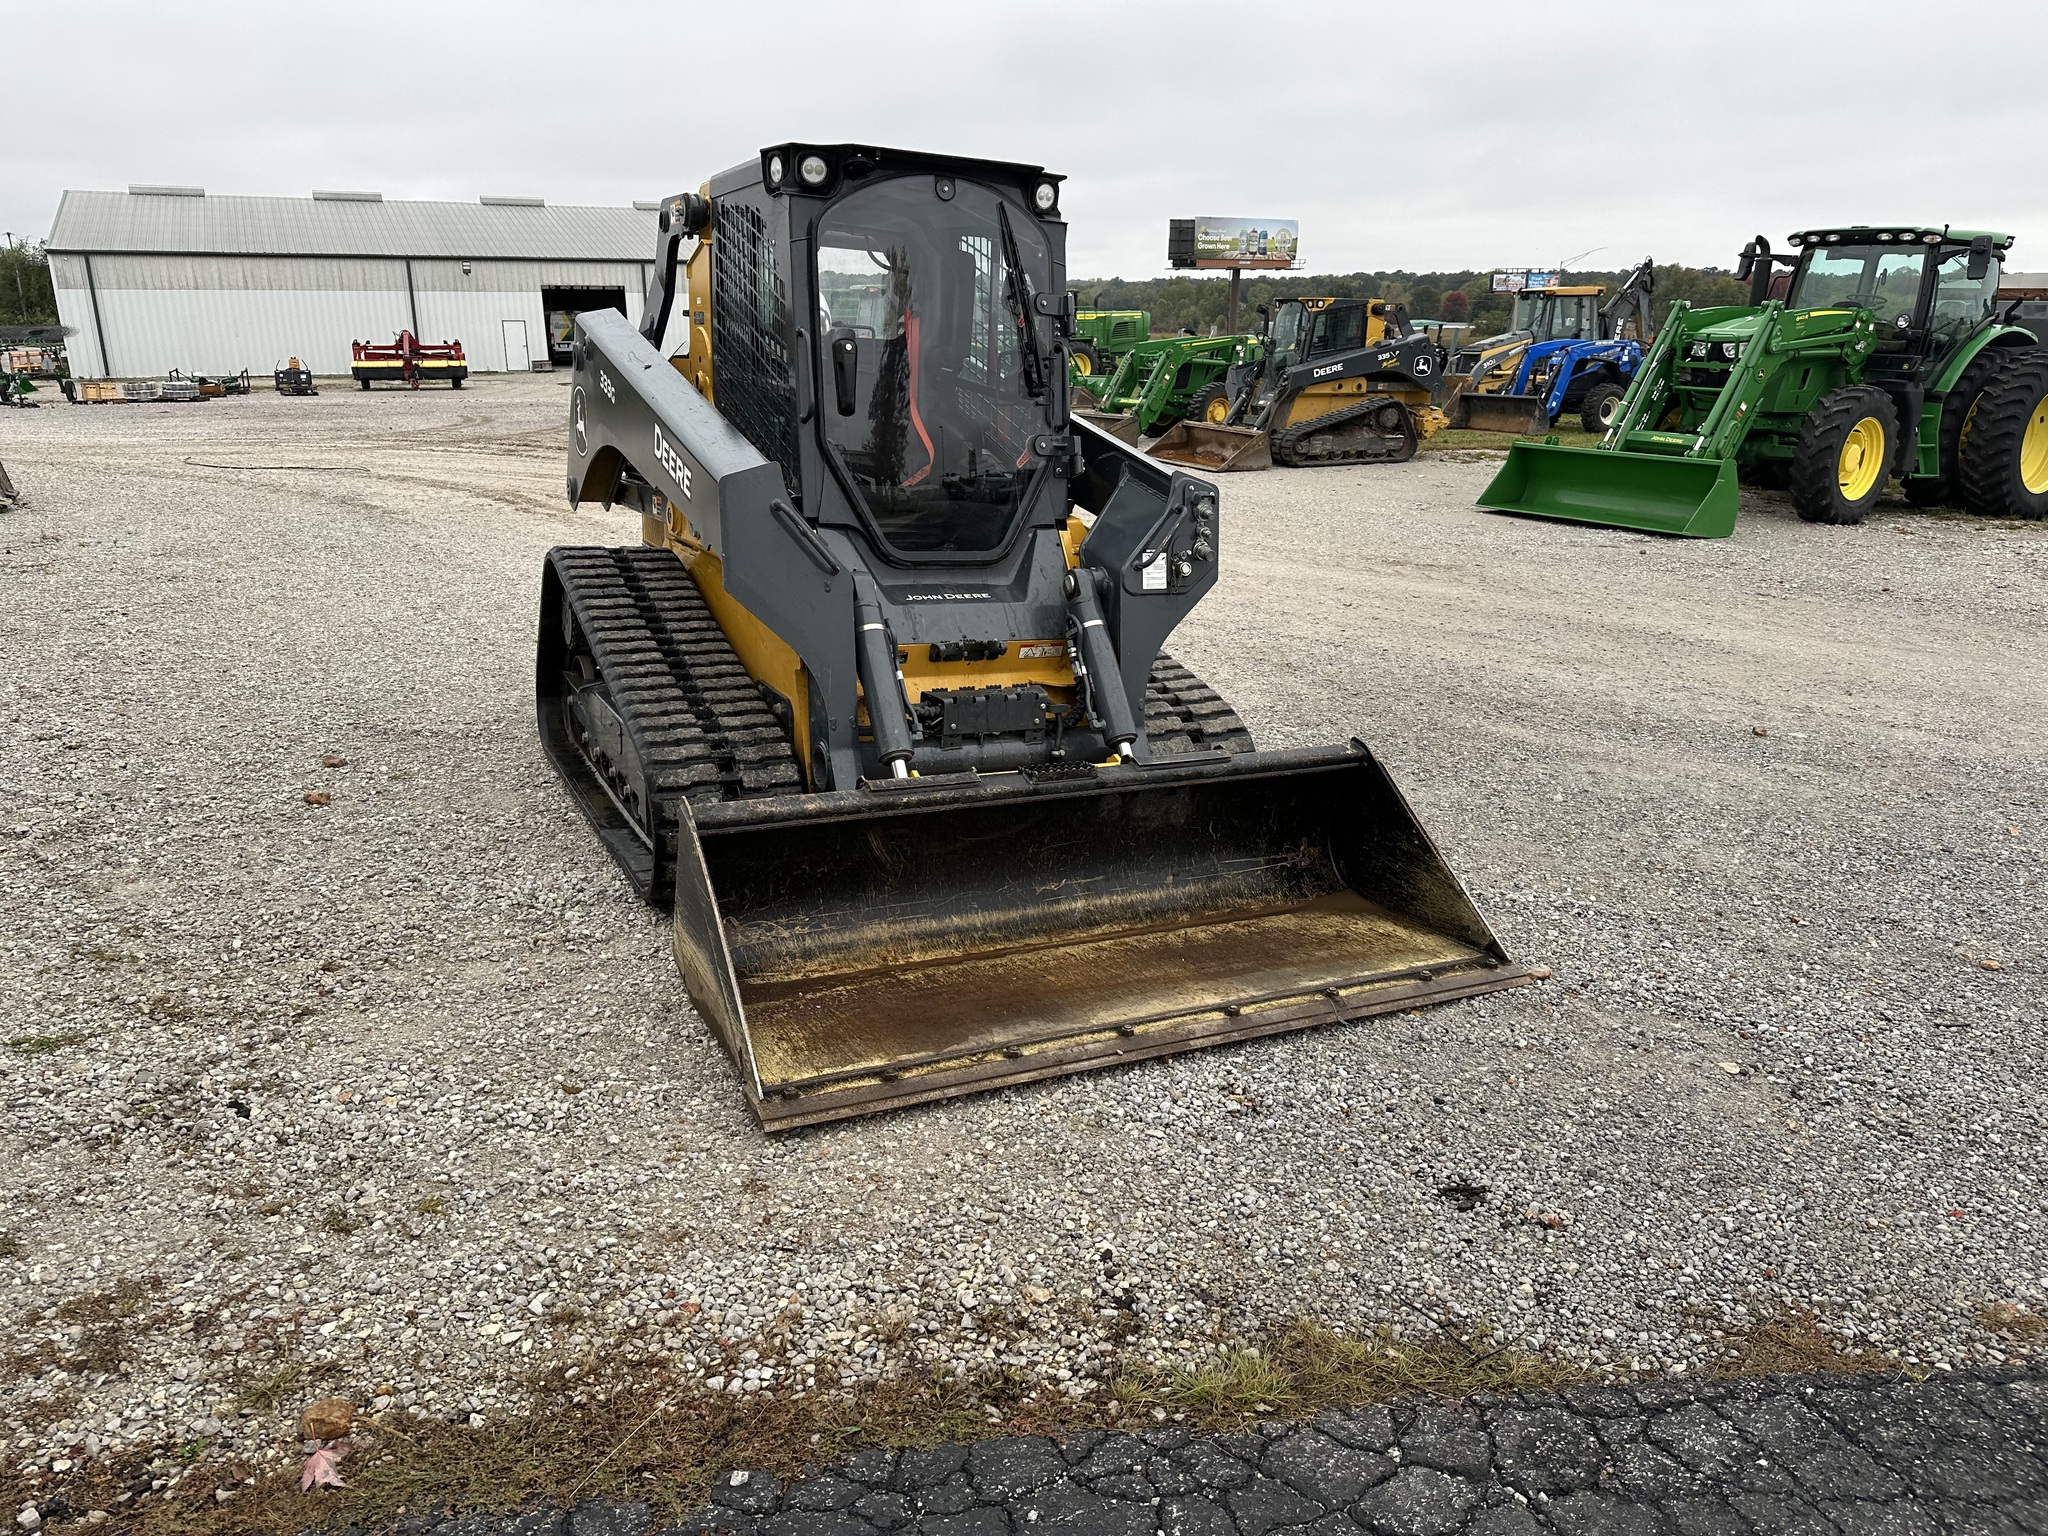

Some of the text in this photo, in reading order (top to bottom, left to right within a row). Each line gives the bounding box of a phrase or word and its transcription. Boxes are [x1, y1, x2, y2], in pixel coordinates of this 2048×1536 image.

[1197, 233, 1220, 241] Choose
[1614, 317, 1624, 340] ERE
[1377, 352, 1391, 361] 335
[1482, 358, 1496, 369] 310J
[1313, 363, 1344, 378] DEERE
[600, 369, 616, 404] 333G
[654, 422, 692, 499] DEERE
